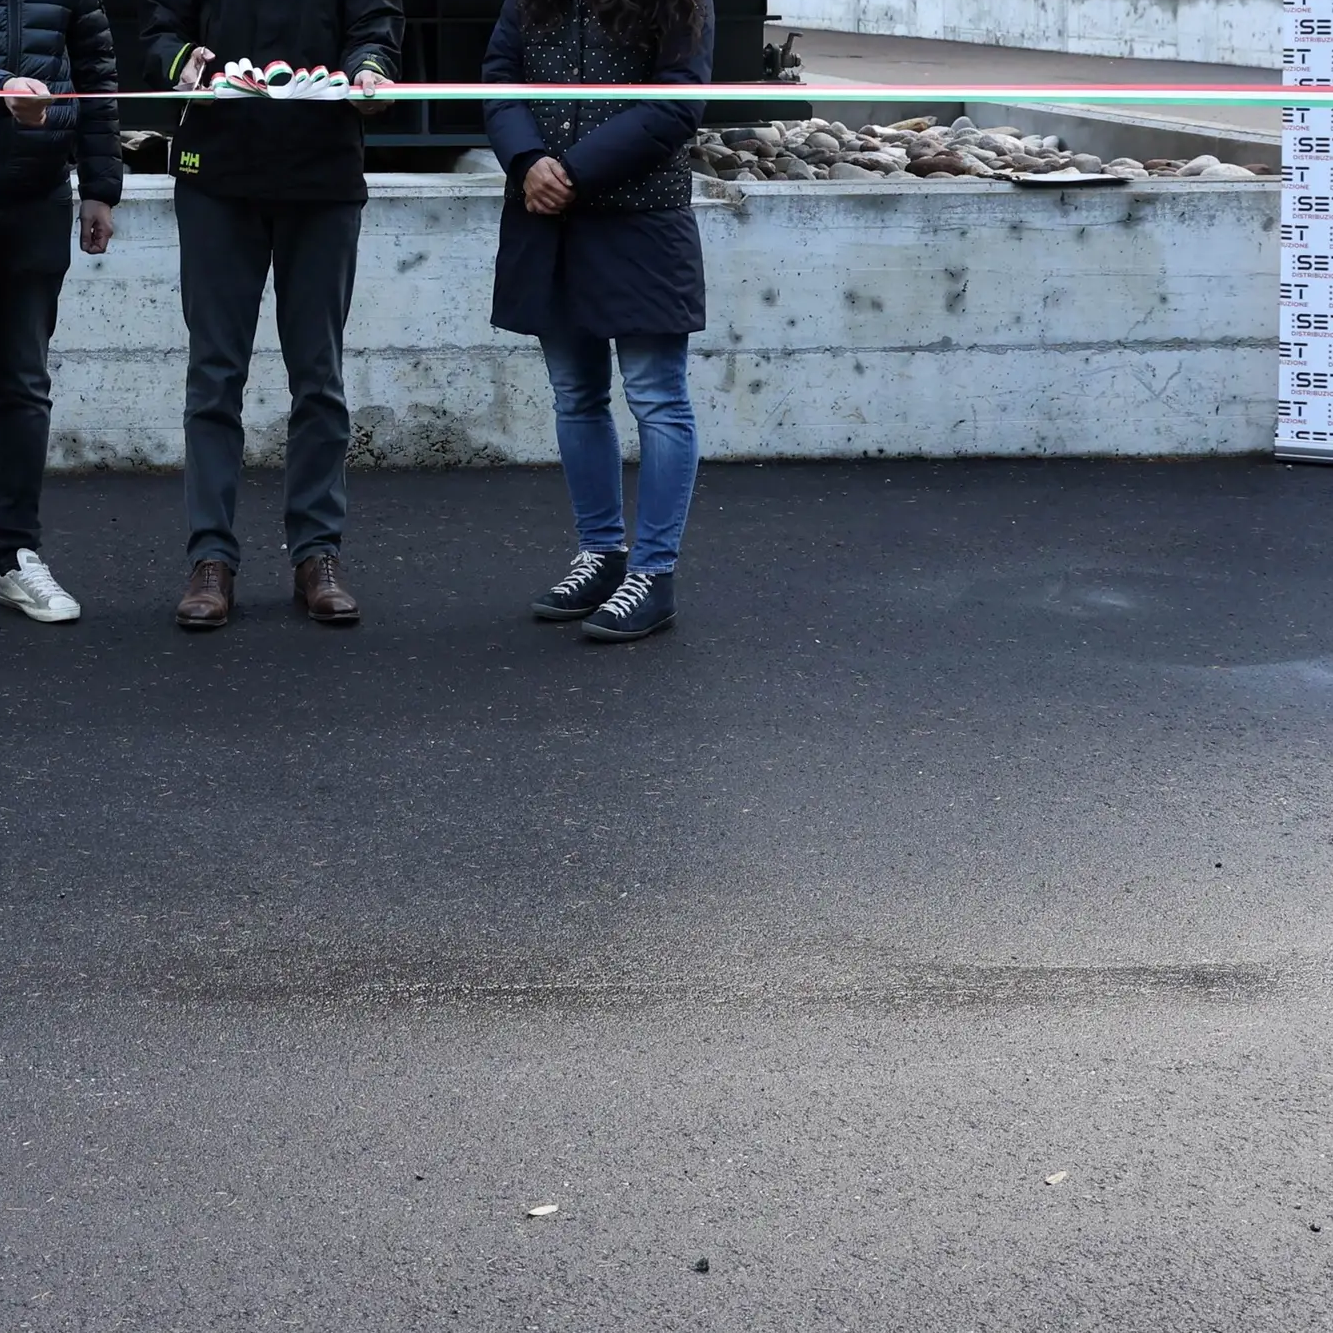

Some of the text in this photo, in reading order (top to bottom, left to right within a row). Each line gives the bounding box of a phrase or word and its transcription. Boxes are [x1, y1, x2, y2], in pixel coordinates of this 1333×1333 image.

[1298, 137, 1333, 153] SE
[1298, 196, 1333, 212] SE
[1297, 255, 1333, 271] SE
[1296, 313, 1333, 330] SE
[1296, 372, 1333, 389] SE
